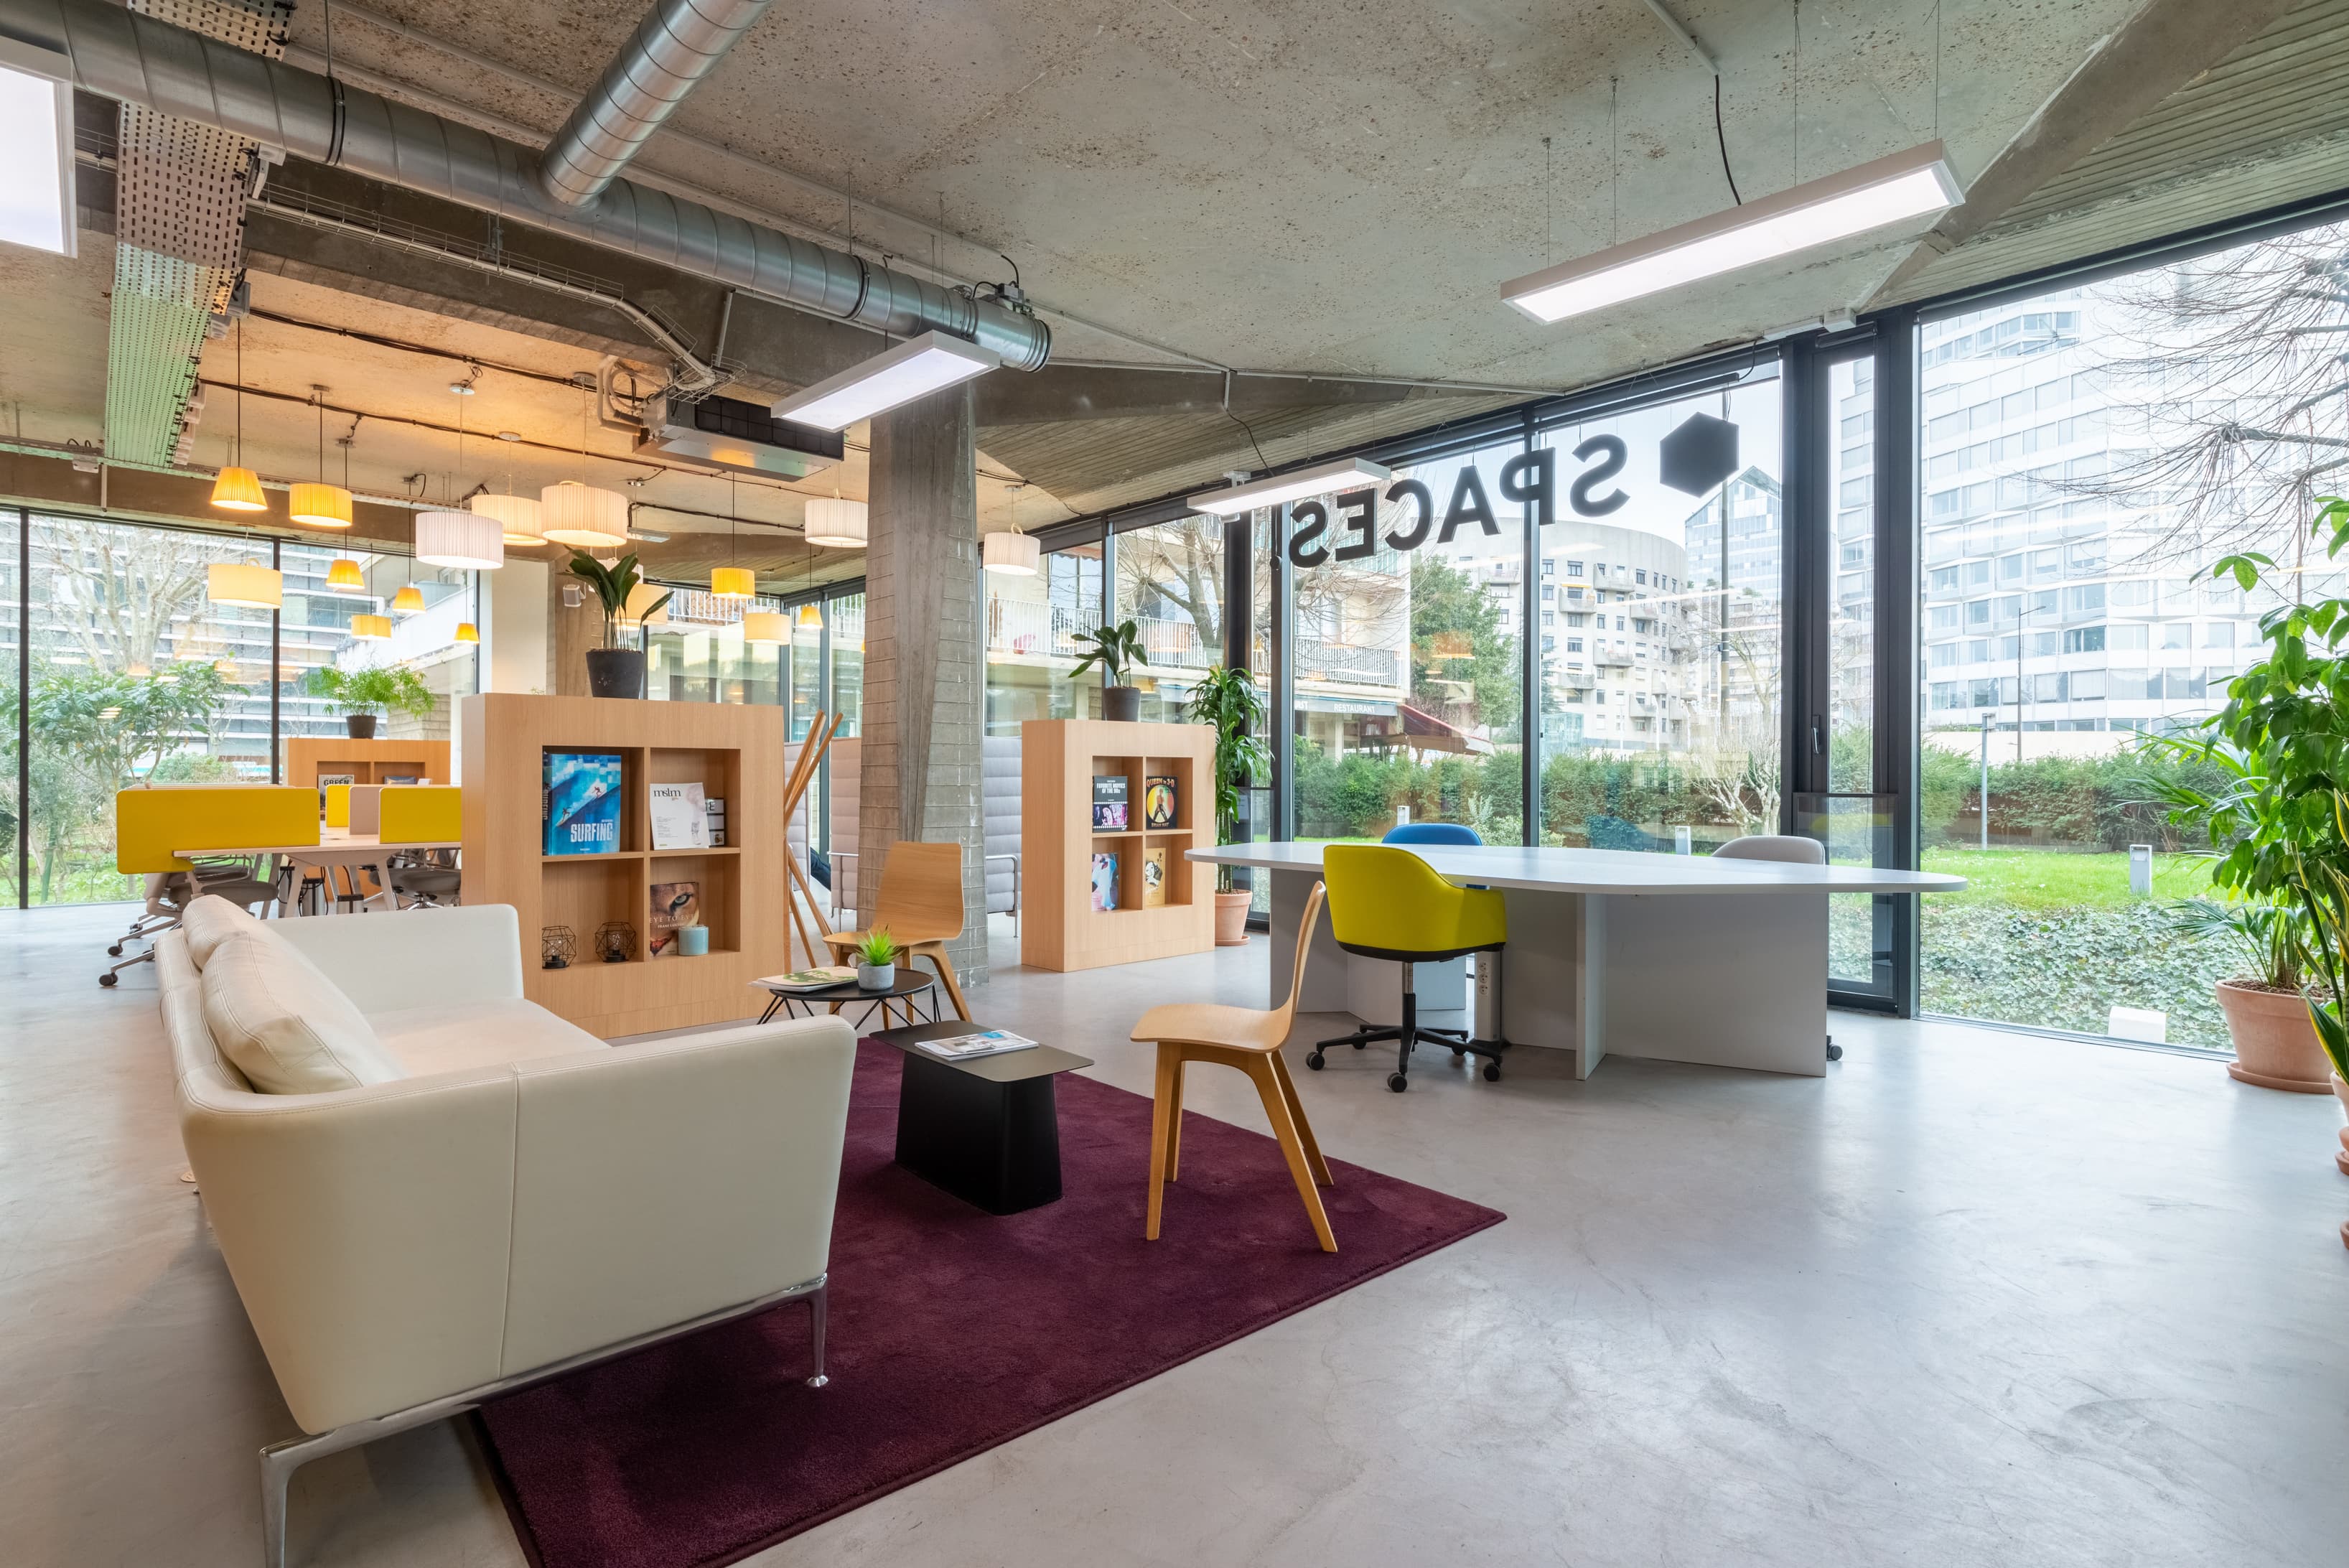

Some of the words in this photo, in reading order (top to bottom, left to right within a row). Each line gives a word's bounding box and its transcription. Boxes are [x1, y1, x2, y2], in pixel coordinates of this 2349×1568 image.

[1334, 704, 1376, 713] RESTAURANT
[1147, 778, 1162, 788] QUEEN
[571, 823, 613, 842] SURFING
